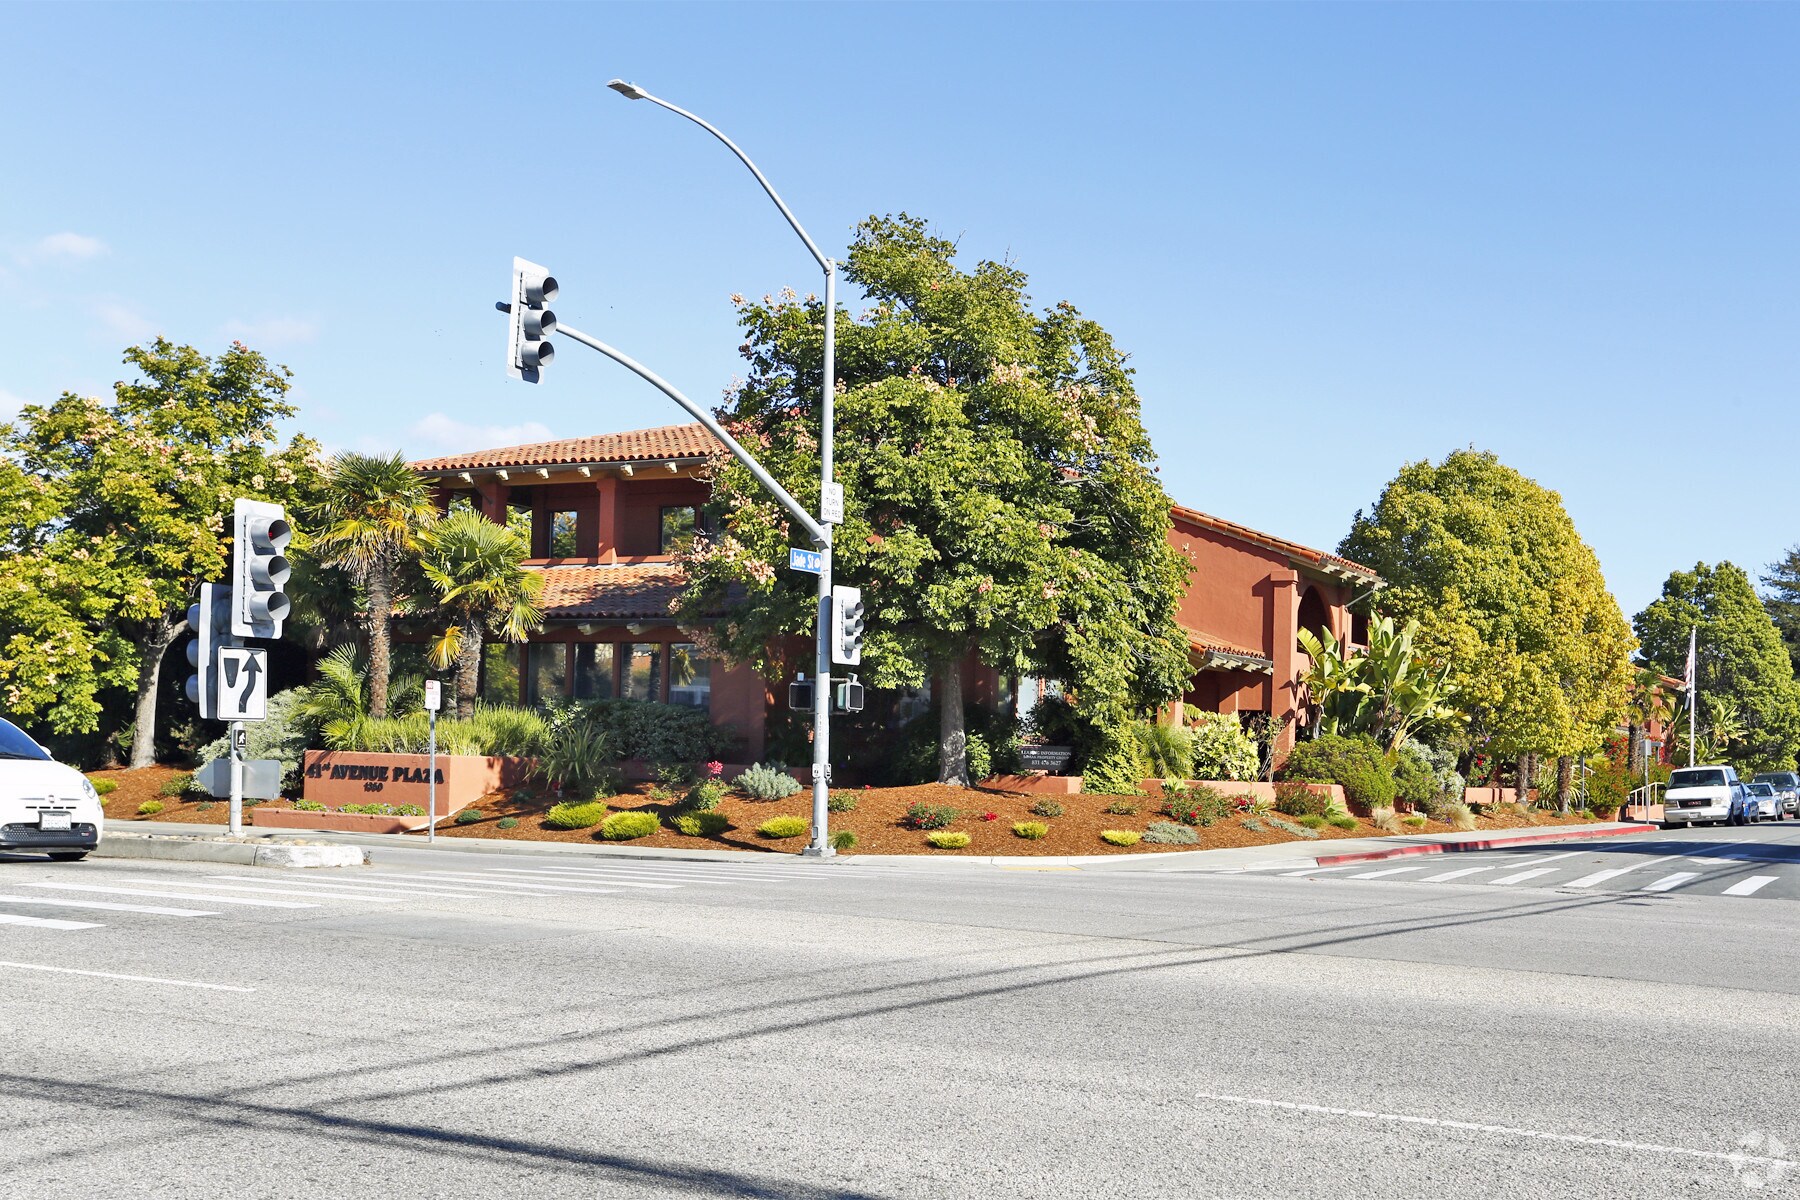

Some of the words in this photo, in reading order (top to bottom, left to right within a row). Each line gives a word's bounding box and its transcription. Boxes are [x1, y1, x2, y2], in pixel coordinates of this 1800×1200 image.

[823, 497, 839, 506] TURN
[823, 508, 830, 516] ON
[832, 510, 841, 518] RED
[792, 552, 806, 568] Jade
[807, 554, 814, 569] St
[330, 764, 389, 782] AVENUE
[392, 767, 445, 784] PLAZA
